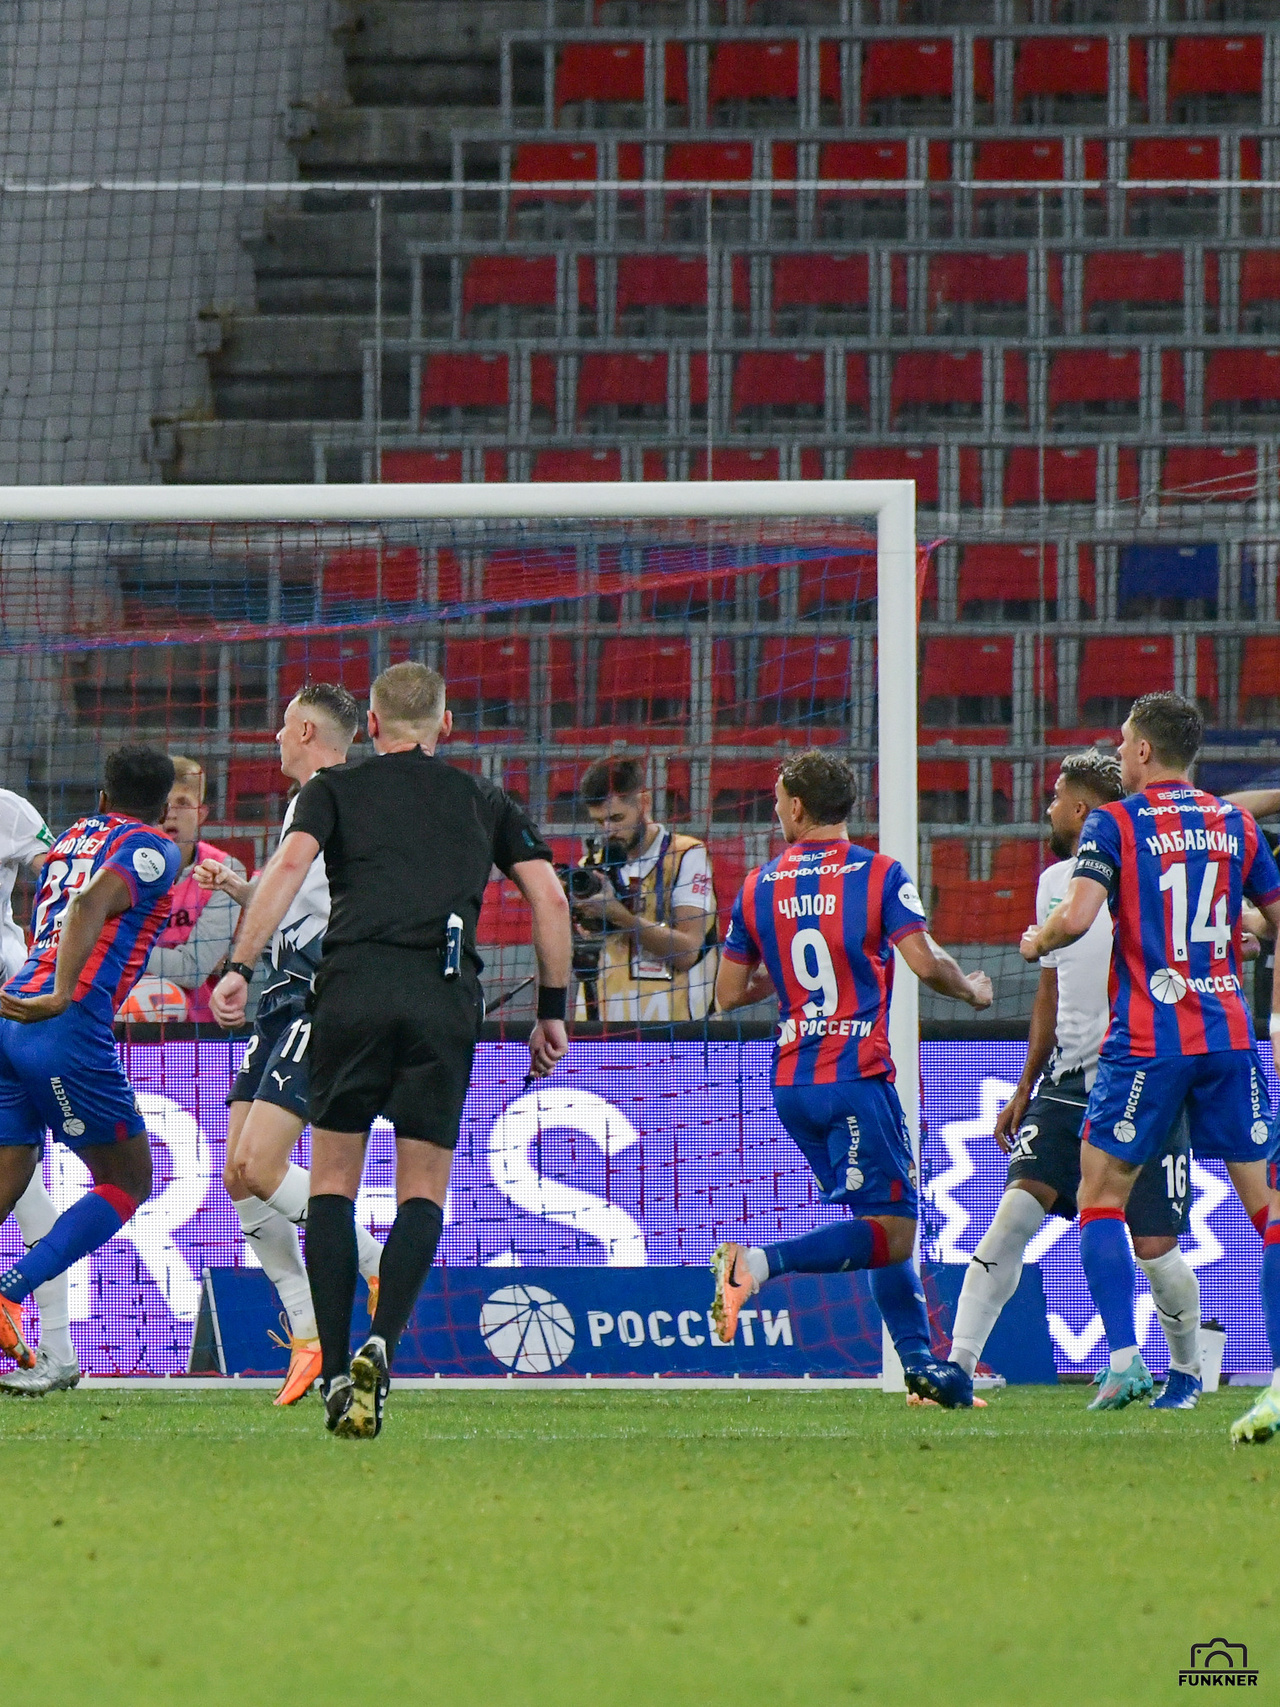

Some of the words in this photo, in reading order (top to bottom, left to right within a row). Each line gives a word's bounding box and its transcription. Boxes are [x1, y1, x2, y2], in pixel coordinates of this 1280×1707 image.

[1137, 805, 1217, 817] АЭРОФЛОТ
[1146, 829, 1238, 856] НАБАБКИН
[762, 864, 840, 883] АЭРОФЛОТ
[778, 894, 837, 919] ЧАЛОВ
[1159, 861, 1232, 962] 14
[791, 928, 839, 1019] 9
[280, 1018, 312, 1063] 11
[799, 1020, 872, 1037] РОССЕТИ
[50, 1076, 74, 1118] РОССЕТИ
[1124, 1071, 1146, 1120] РОССЕТИ
[846, 1115, 860, 1165] РОССЕТИ
[1162, 1154, 1187, 1198] 16
